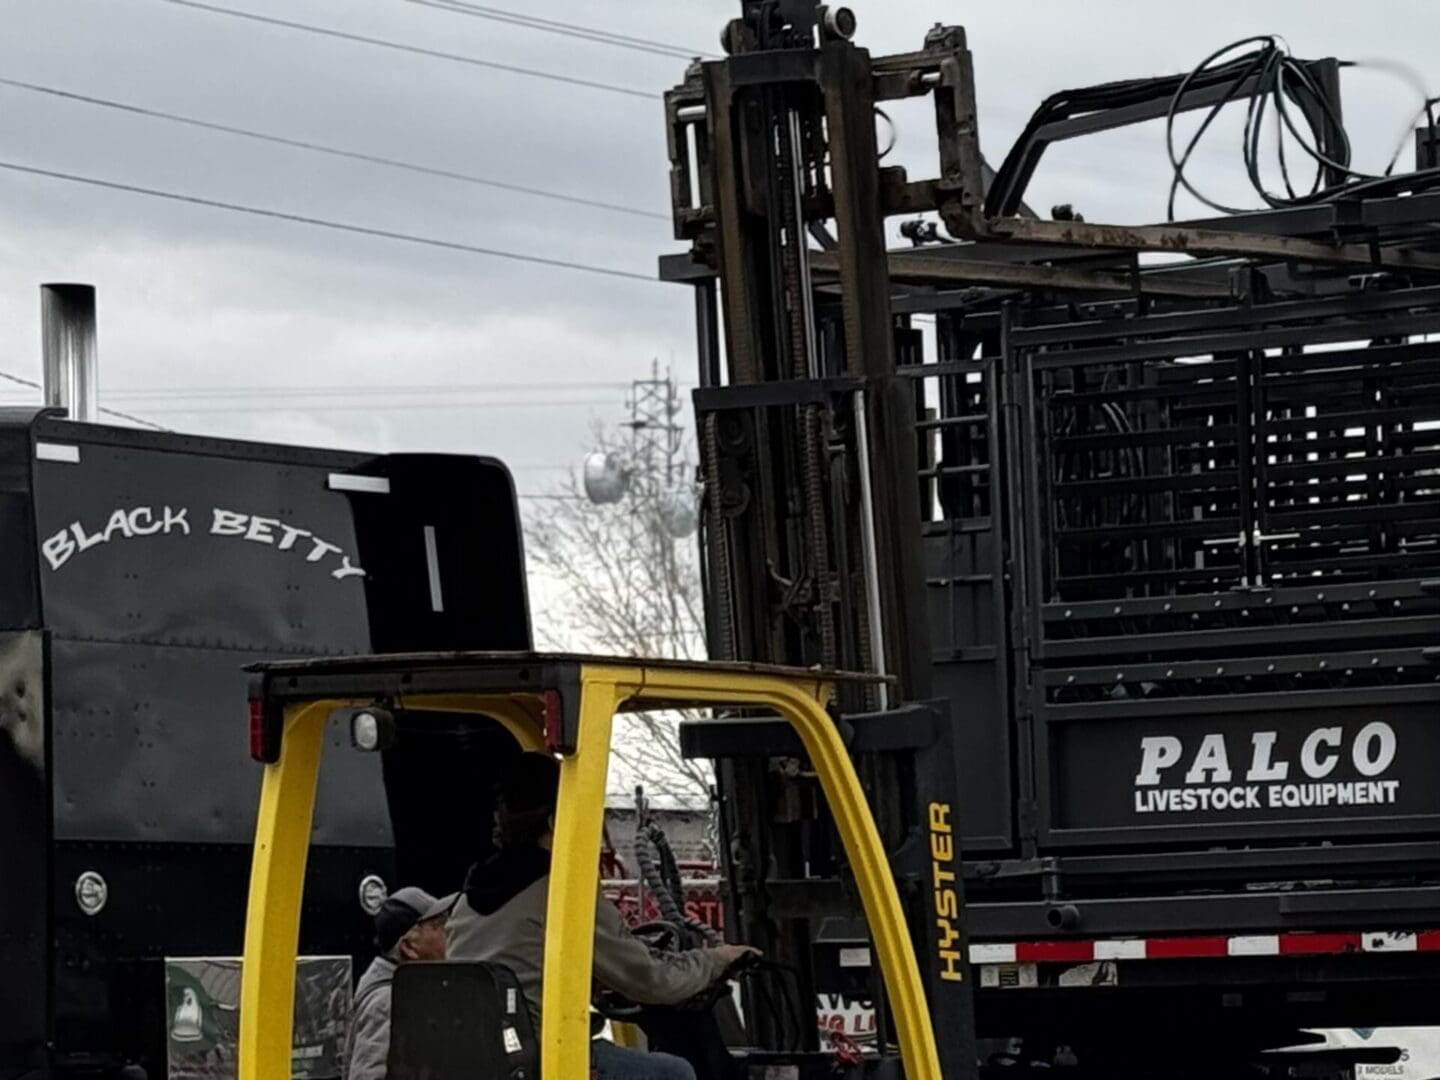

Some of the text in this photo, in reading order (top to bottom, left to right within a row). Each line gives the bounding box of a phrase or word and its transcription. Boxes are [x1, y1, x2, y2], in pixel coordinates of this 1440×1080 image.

[41, 505, 366, 578] BLACK BETTY
[1135, 721, 1396, 785] PALCO
[1135, 780, 1399, 812] LIVESTOCK EQUIPMENT
[929, 802, 962, 981] HYSTER
[1365, 1065, 1404, 1075] MODELS
